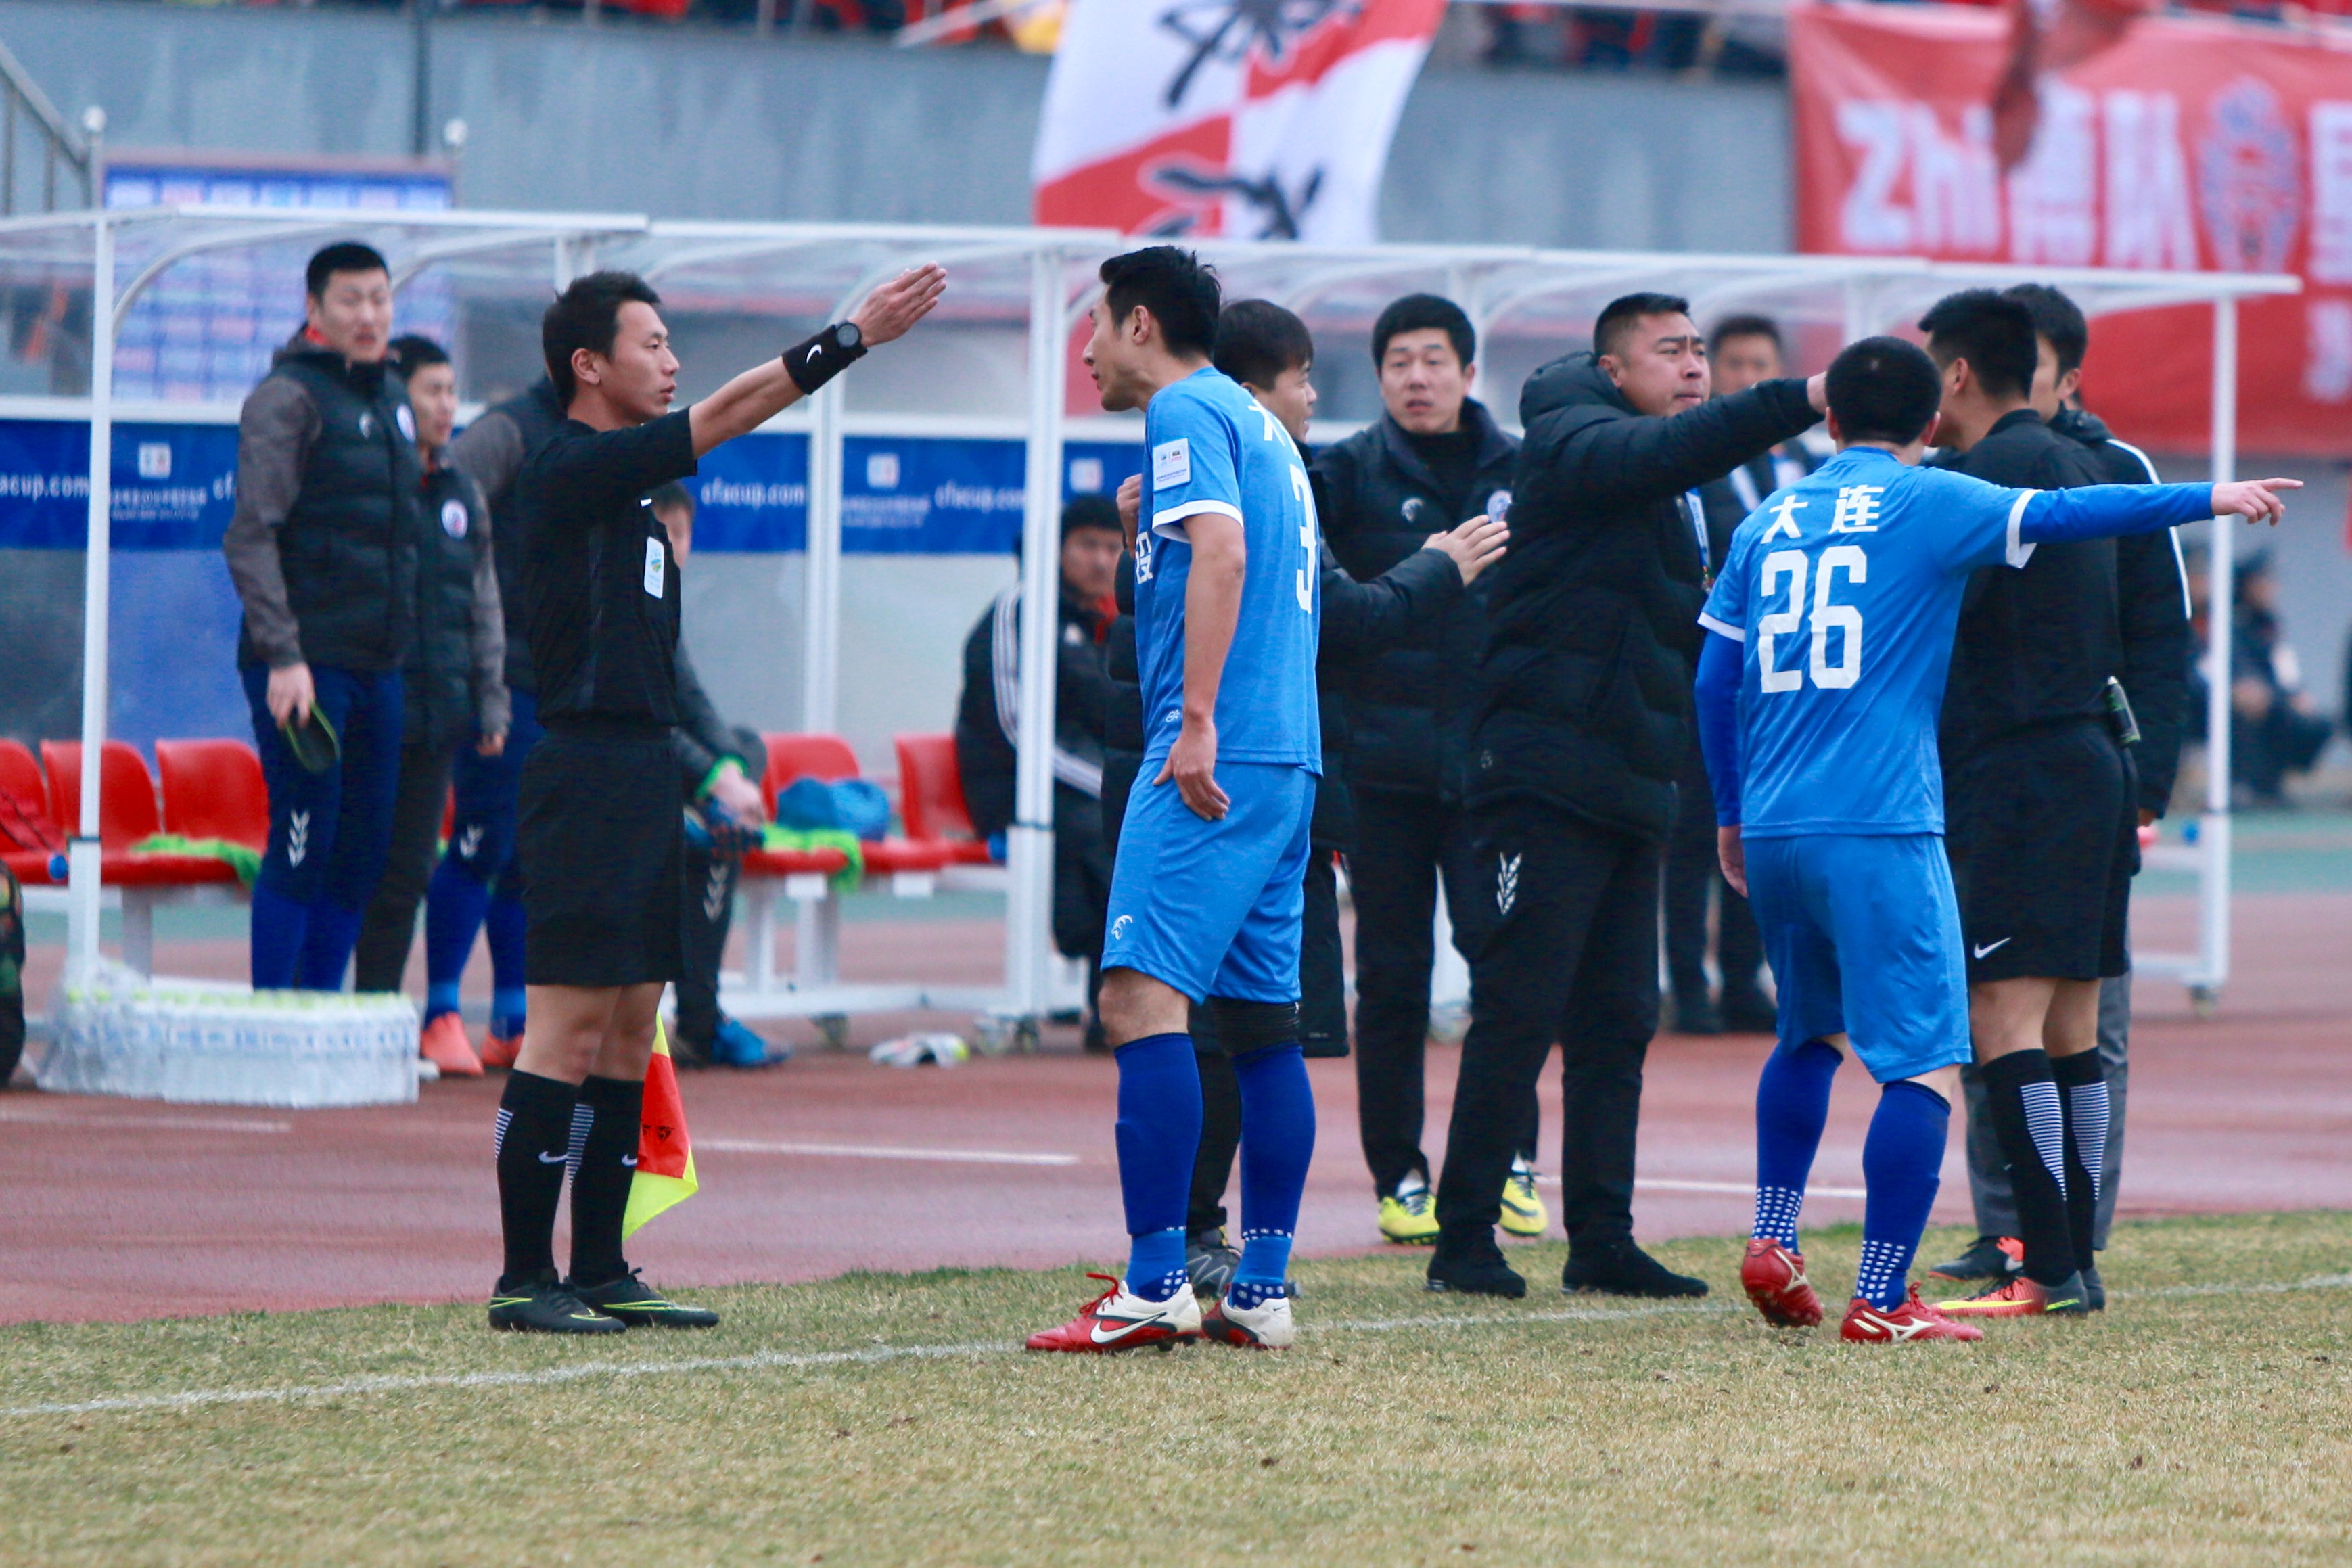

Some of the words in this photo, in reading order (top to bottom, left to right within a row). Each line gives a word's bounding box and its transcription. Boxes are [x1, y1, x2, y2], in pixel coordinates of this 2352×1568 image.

[701, 477, 806, 511] cfacup.com
[1760, 484, 1885, 544] 大连
[1758, 545, 1867, 693] 26
